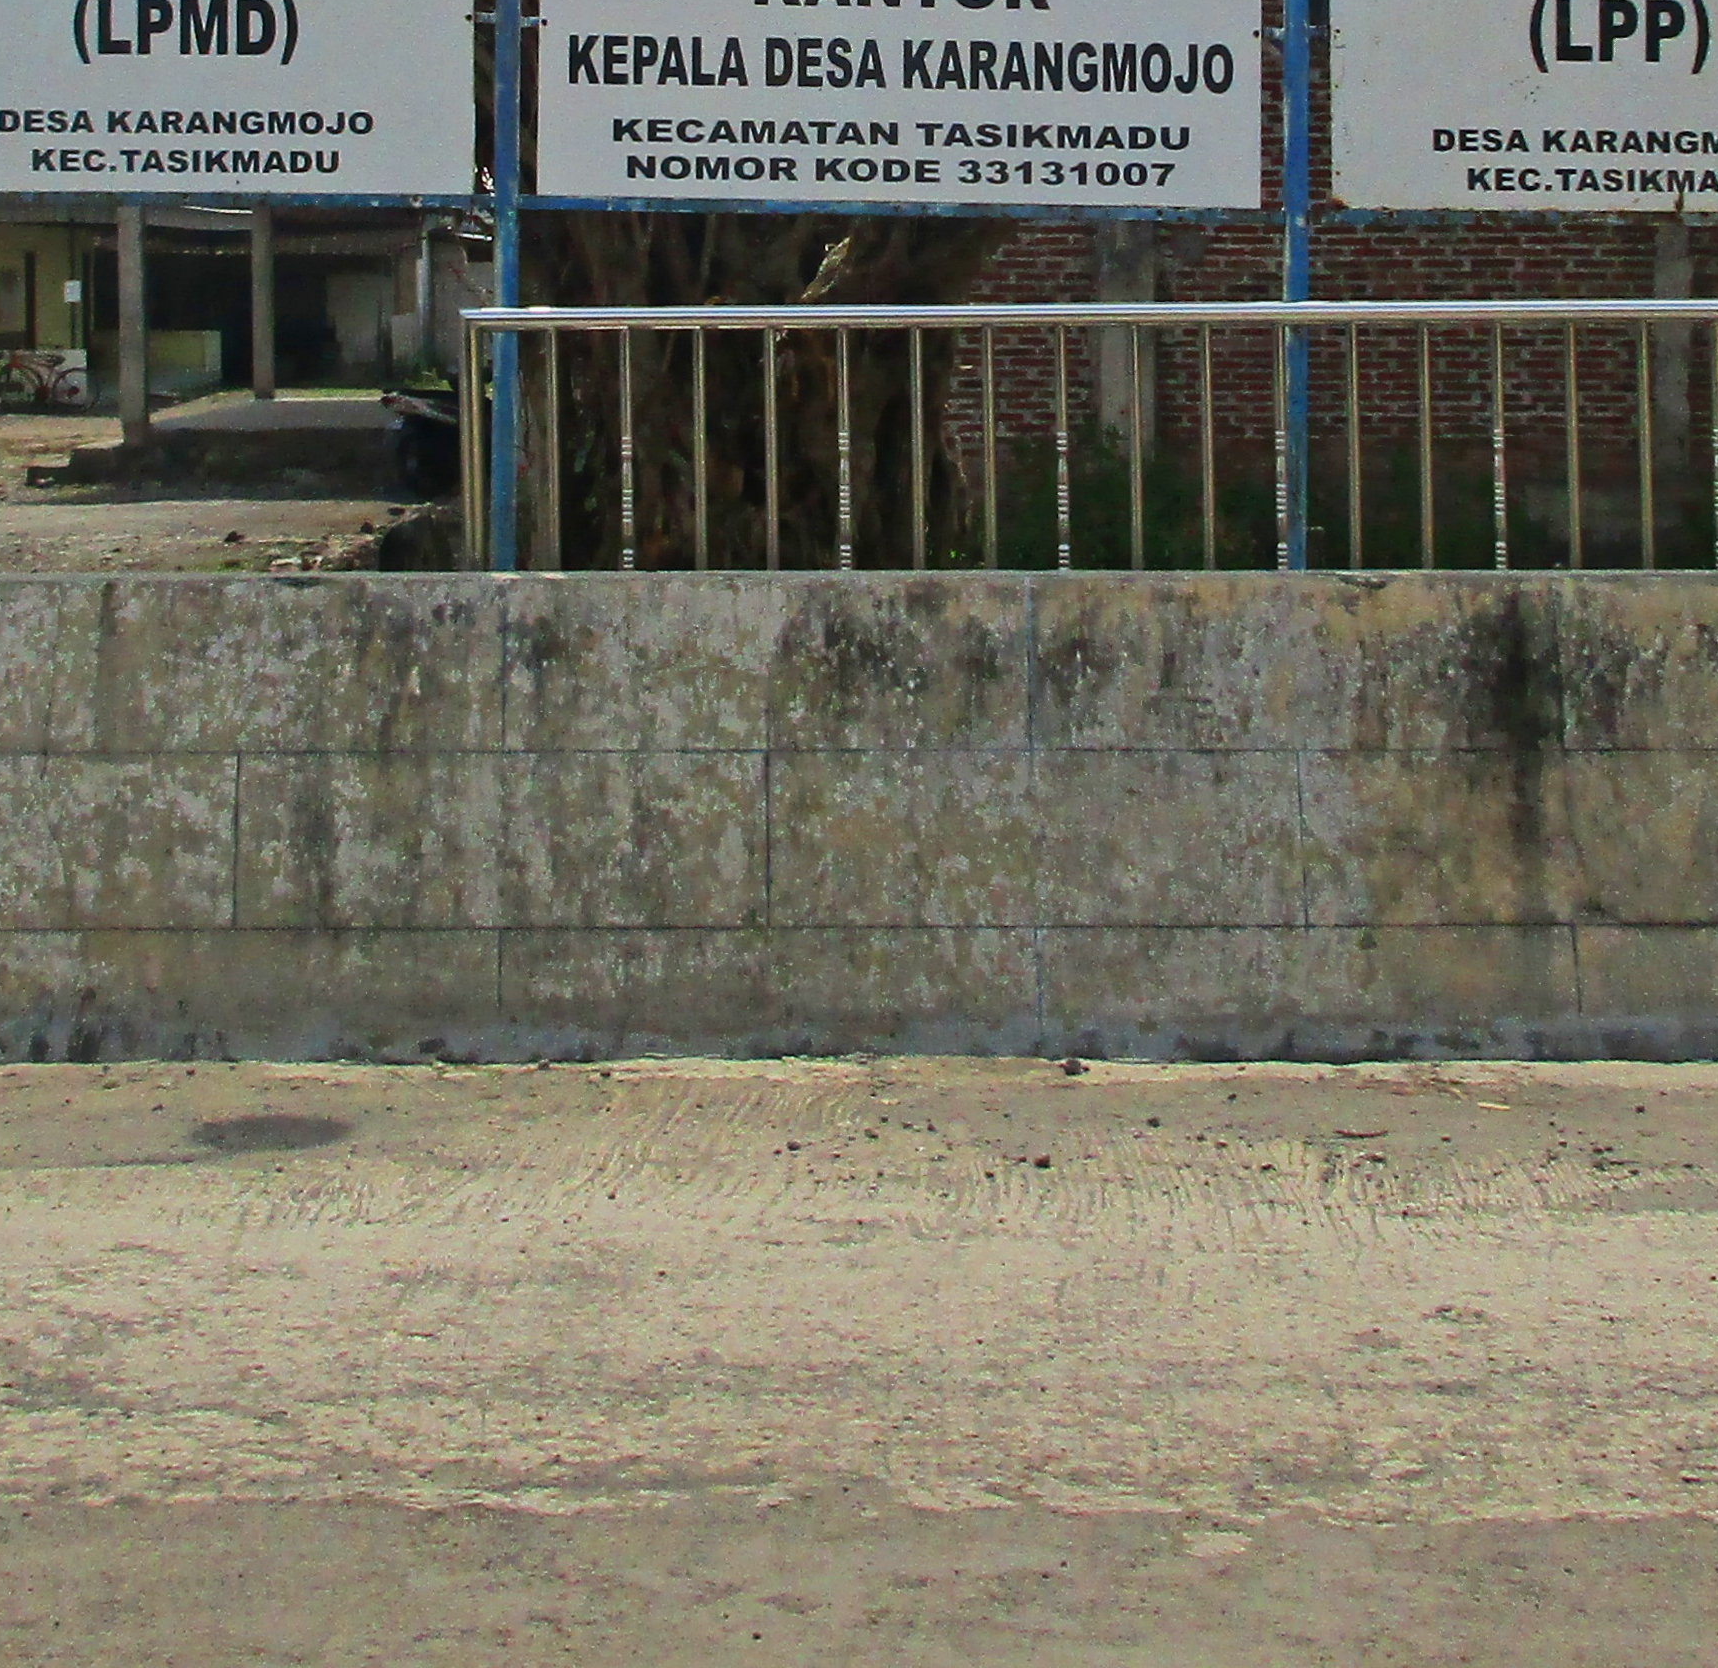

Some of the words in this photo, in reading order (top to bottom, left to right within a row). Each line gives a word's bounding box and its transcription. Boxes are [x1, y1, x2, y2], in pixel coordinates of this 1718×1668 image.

[568, 34, 749, 87] KEPALA
[764, 37, 887, 89] DESA
[902, 39, 1235, 95] KARANGMOJO
[107, 110, 374, 136] KARANGMOJO
[612, 118, 899, 146] KECAMATAN
[915, 122, 1190, 151] TASIKMADU
[1432, 128, 1530, 153] DESA
[626, 155, 798, 182] NOMOR
[815, 157, 941, 184] KODE
[958, 159, 1176, 187] 33131007
